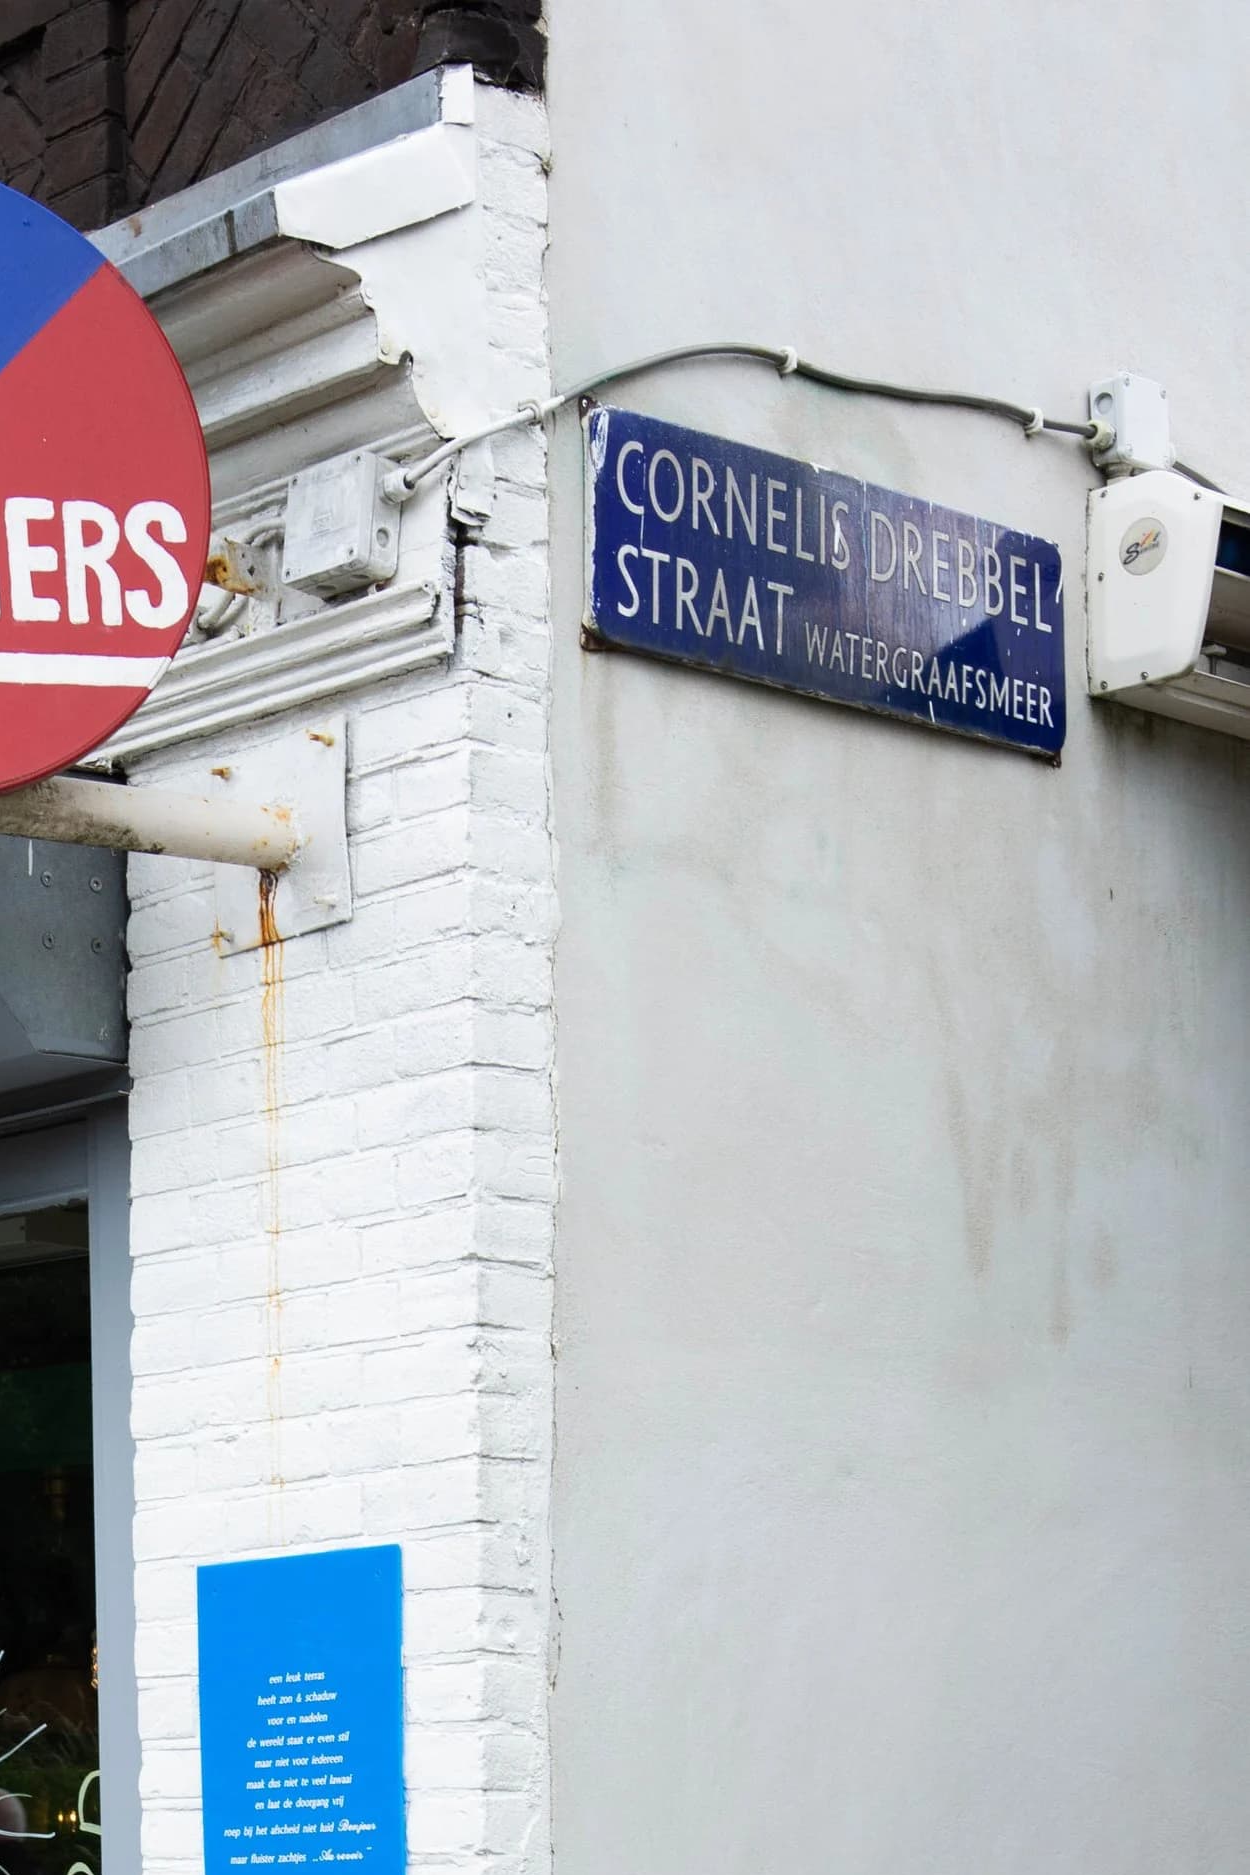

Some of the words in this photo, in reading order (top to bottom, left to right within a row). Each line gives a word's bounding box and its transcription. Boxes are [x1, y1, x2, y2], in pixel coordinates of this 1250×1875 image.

[616, 440, 851, 571] CORNELIS
[870, 510, 1052, 633] DREBBEL
[616, 544, 795, 656] STRAAT
[805, 621, 1054, 729] WATERGRAAFSMEER
[269, 1676, 283, 1684] een
[286, 1672, 301, 1682] leuk
[304, 1672, 325, 1681] terras
[257, 1695, 276, 1705] heeft
[279, 1696, 293, 1704] zon
[296, 1693, 302, 1703] &
[305, 1690, 337, 1702] schaduw
[299, 1712, 328, 1723] nadelen
[247, 1738, 257, 1748] de
[260, 1736, 284, 1747] wereld
[286, 1736, 304, 1745] staat
[306, 1736, 315, 1744] er
[317, 1735, 335, 1743] even
[255, 1760, 272, 1768] maar
[275, 1758, 289, 1767] niet
[292, 1758, 309, 1766] voor
[311, 1754, 343, 1764] iedereen
[246, 1779, 265, 1789] maak
[268, 1778, 281, 1788] dus
[284, 1778, 298, 1787] niet
[301, 1778, 309, 1786] te
[312, 1775, 327, 1785] veel
[329, 1774, 352, 1784] lawaai
[255, 1802, 264, 1810] en
[267, 1799, 280, 1809] laat
[283, 1798, 293, 1808] de
[295, 1797, 329, 1809] doorgang
[332, 1796, 344, 1807] vrij
[224, 1829, 241, 1839] roep
[243, 1826, 253, 1838] bij
[256, 1825, 268, 1835] het
[270, 1824, 300, 1835] afscheid
[302, 1824, 317, 1833] niet
[320, 1822, 334, 1832] luid
[251, 1853, 275, 1864] fluister
[278, 1852, 306, 1864] zachtjes
